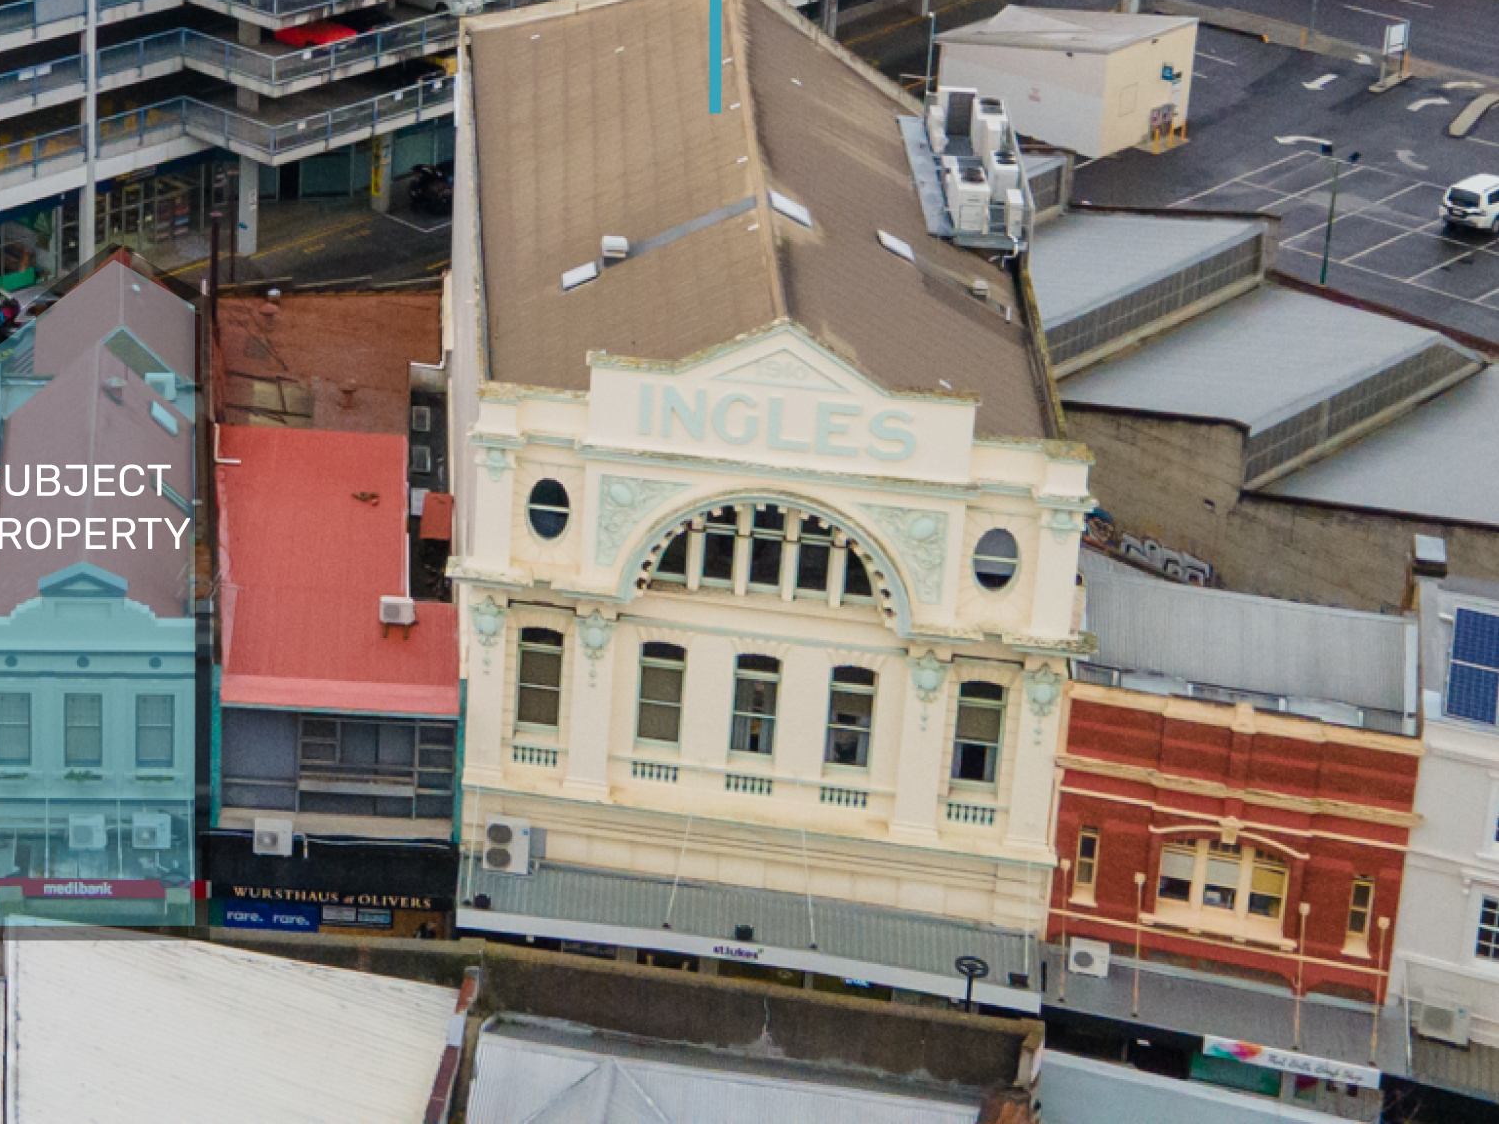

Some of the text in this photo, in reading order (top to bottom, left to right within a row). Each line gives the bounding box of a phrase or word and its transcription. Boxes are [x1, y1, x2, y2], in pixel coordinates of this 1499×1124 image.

[638, 382, 917, 462] INGLES
[43, 881, 113, 895] medibank
[233, 885, 339, 903] WURSTHAUS
[357, 893, 431, 909] OLIVERS
